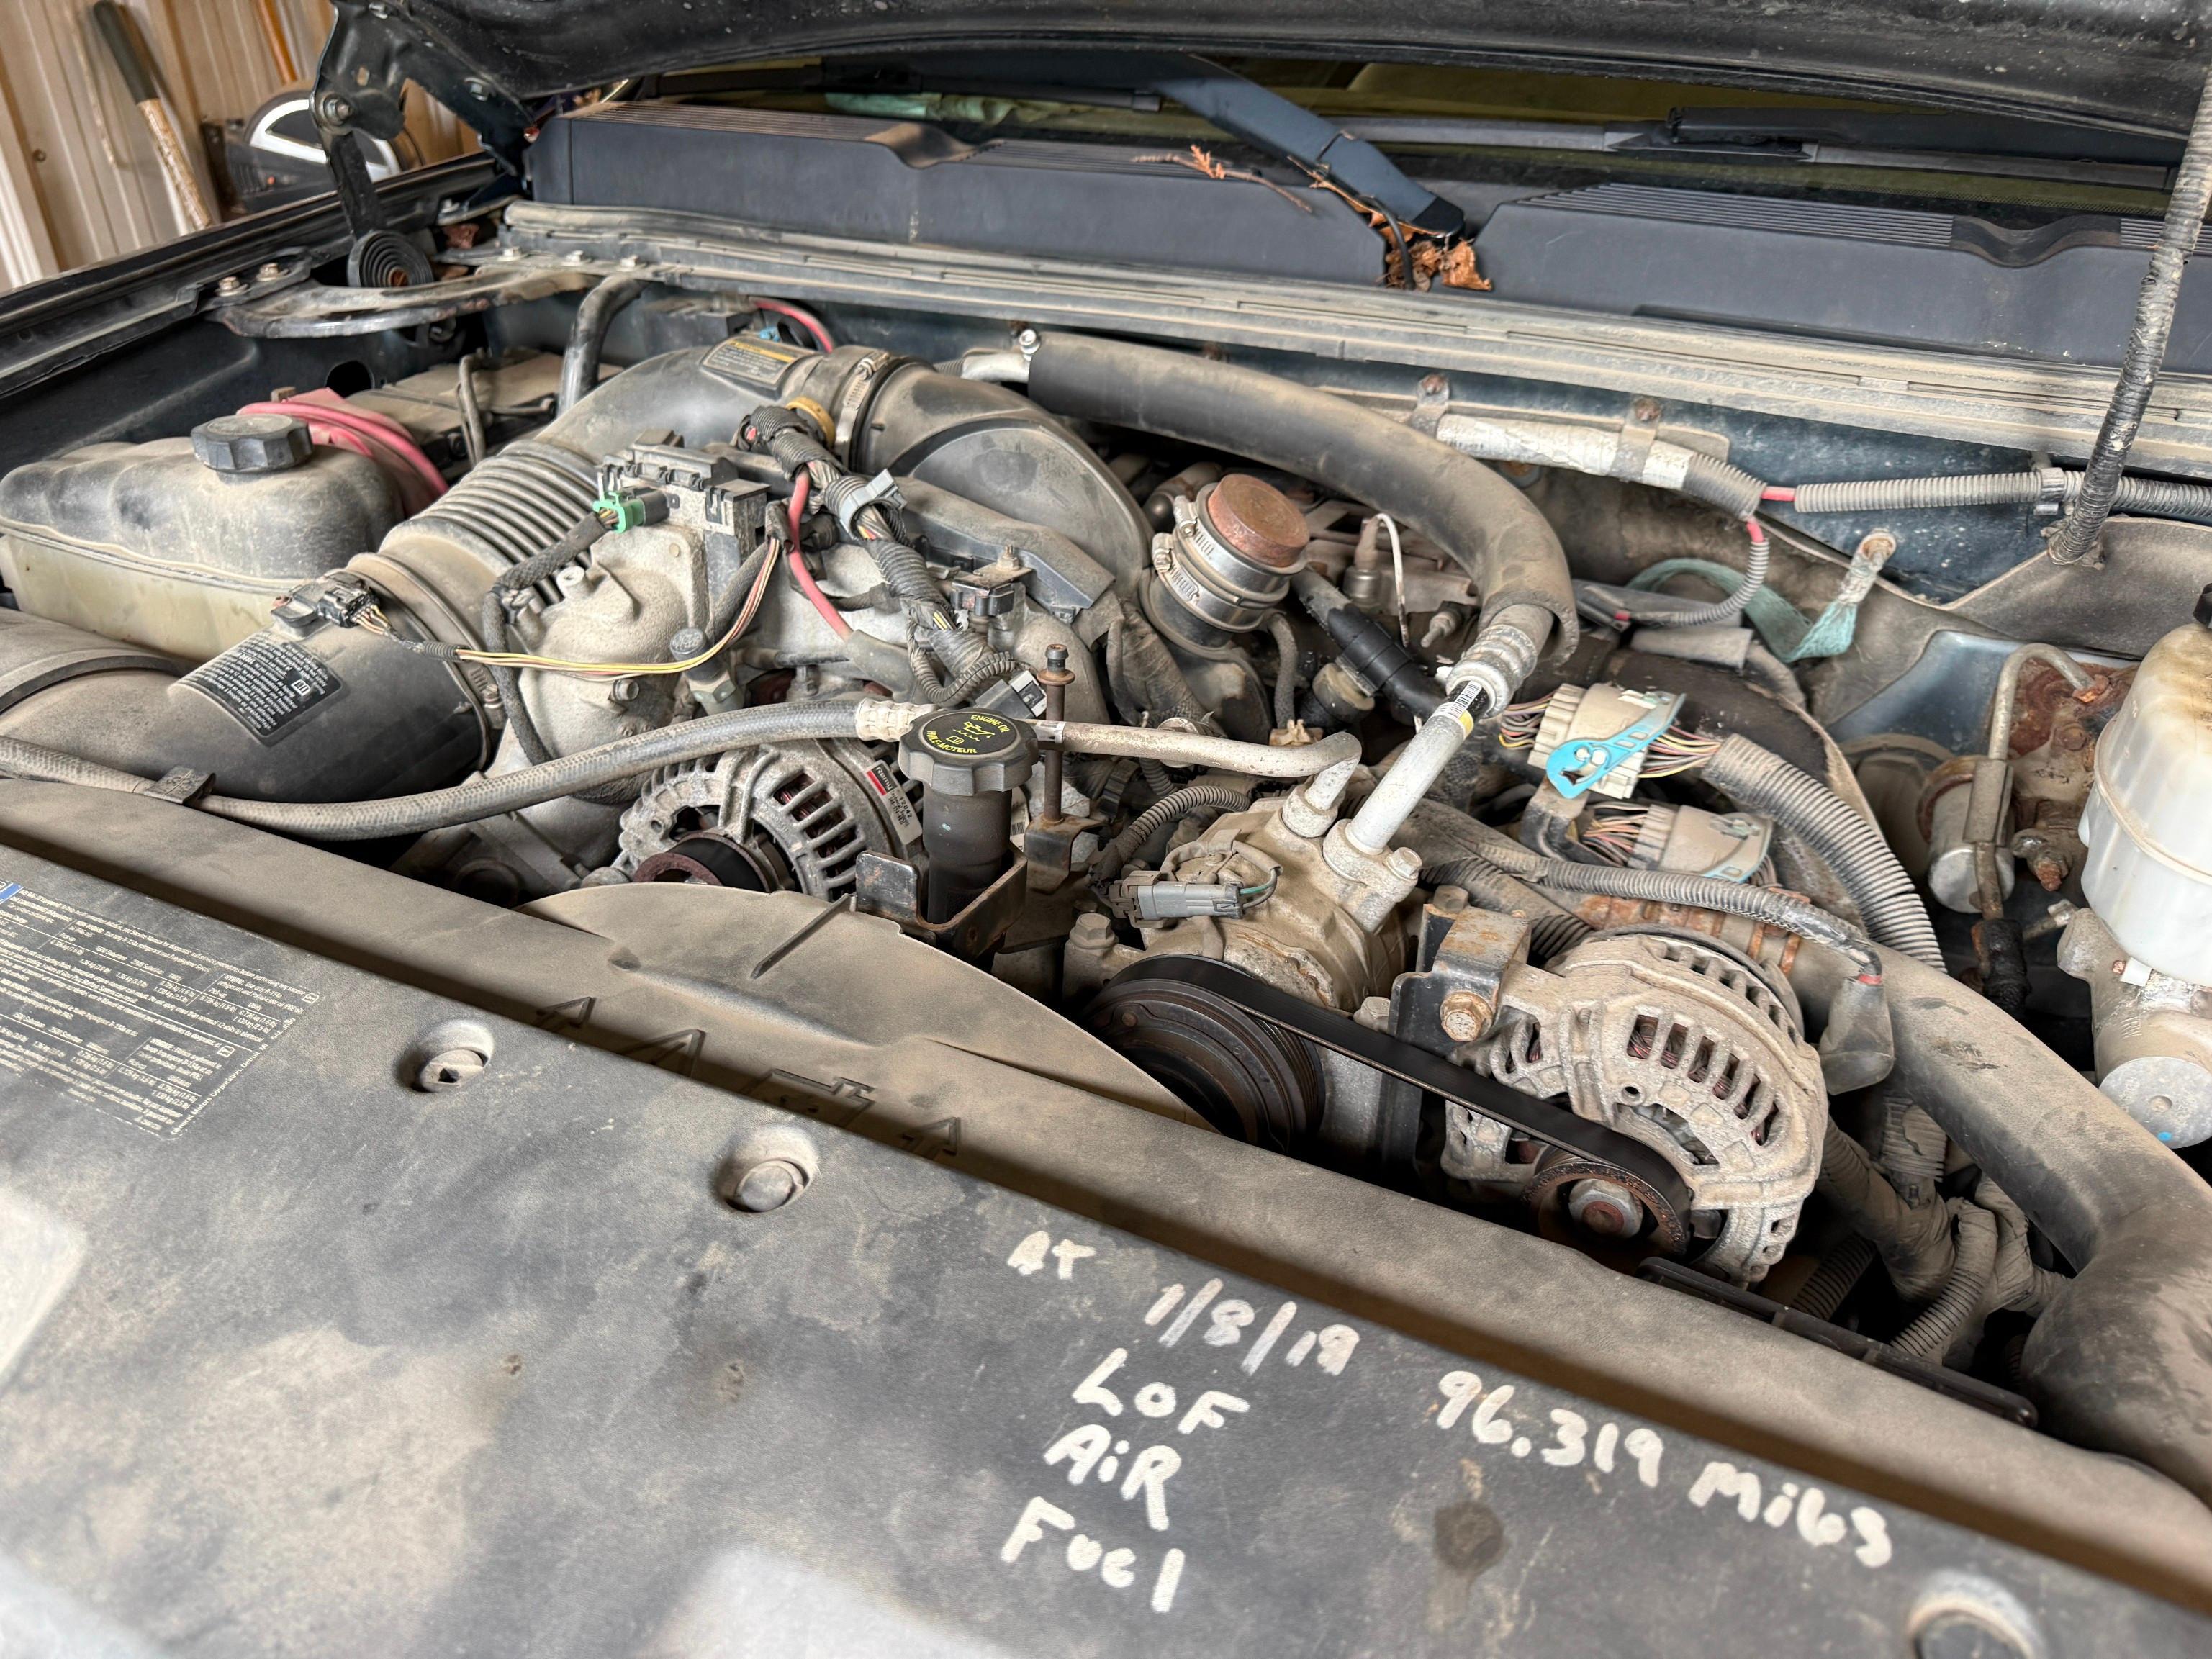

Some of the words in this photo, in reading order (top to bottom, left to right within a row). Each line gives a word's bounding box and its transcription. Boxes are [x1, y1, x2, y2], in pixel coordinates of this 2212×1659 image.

[970, 715, 1003, 726] ENGINE
[926, 731, 978, 754] HUILE-MOTEUR
[875, 767, 893, 790] Remy
[1145, 1278, 1360, 1376] 1/8/19
